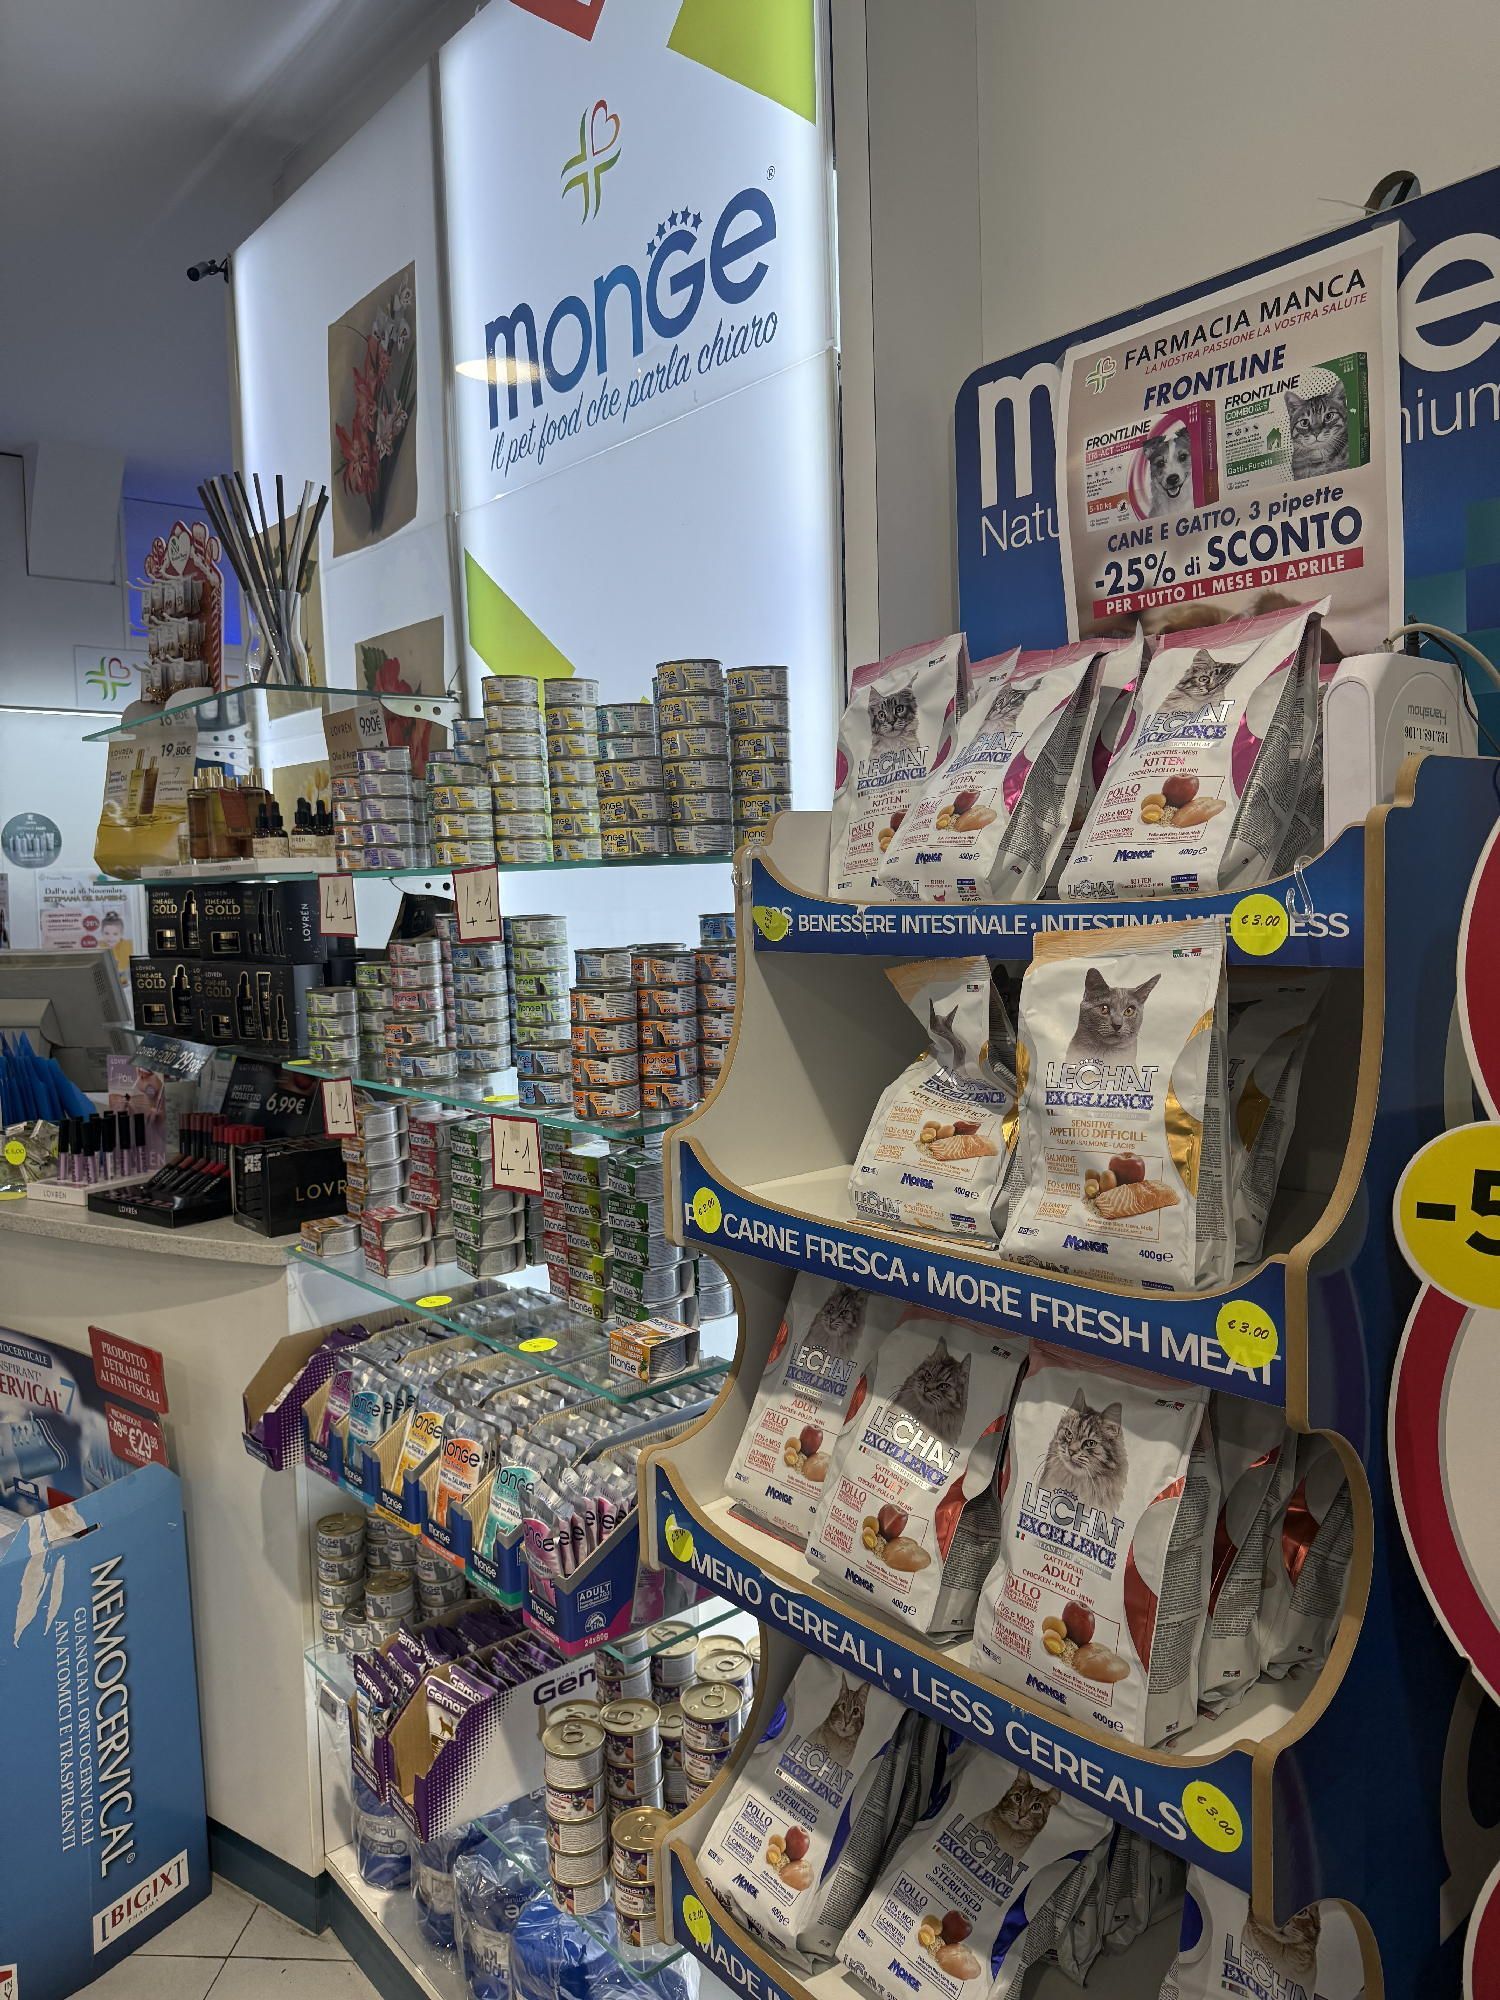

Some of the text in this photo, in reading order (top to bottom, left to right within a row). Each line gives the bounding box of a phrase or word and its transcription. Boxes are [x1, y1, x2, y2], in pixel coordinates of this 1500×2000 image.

[1124, 268, 1366, 370] FARMACIA MANCA
[1145, 291, 1368, 375] LA NOSTRA PASSIONE LA VOSTRA SALUTE
[1143, 343, 1287, 411] FRONTLINE
[1224, 374, 1300, 409] FRONTLINE
[490, 310, 779, 478] Il pet food che parla chiaro
[1226, 405, 1254, 420] COMBO
[1086, 419, 1151, 451] FRONTLINE
[1107, 485, 1344, 553] CANE E GATTO, 3 pipette
[1095, 505, 1363, 597] -25% di SCONTO
[1106, 553, 1345, 616] PER TUTTO IL MESE DI APRILE
[359, 715, 382, 737] 9,90€
[161, 743, 192, 758] 19,80€
[858, 745, 929, 780] LECHAT
[1143, 756, 1186, 767] KITTEN
[856, 766, 926, 791] EXCELLENCE
[1107, 783, 1141, 798] POLLO
[871, 795, 902, 808] KITTEN
[152, 904, 178, 915] GOLD
[204, 904, 241, 916] GOLD
[1252, 914, 1281, 928] 3.00
[798, 914, 897, 934] BENESSERE
[901, 914, 1028, 936] INTESTINALE
[137, 978, 167, 989] GOLD
[206, 986, 232, 998] GOLD
[1045, 1061, 1159, 1093] LECHAT
[266, 1091, 306, 1116] 6,99€
[1044, 1090, 1154, 1110] EXCELLENCE
[1049, 1127, 1148, 1142] APPETITO DIFFICILE
[1071, 1119, 1114, 1128] SENSITIVE
[1046, 1153, 1077, 1164] SALMONE
[900, 1172, 934, 1190] MONGE
[1062, 1234, 1109, 1255] MONGE
[723, 1213, 800, 1256] CARNE
[805, 1233, 908, 1287] FRESCA
[927, 1265, 1022, 1318] MORE
[1031, 1293, 1150, 1353] FRESH
[1239, 1320, 1270, 1340] 3.00
[101, 1341, 148, 1370] PRODOTTO
[790, 1343, 857, 1383] LECHAT
[103, 1356, 152, 1386] DETRAIBILE
[785, 1365, 848, 1397] EXCELLENCE
[60, 1376, 76, 1416] 7
[110, 1372, 160, 1405] FINI FISCALI
[765, 1411, 789, 1427] POLLO
[791, 1399, 820, 1415] ADULT
[868, 1405, 960, 1473] LECHAT
[862, 1428, 949, 1487] EXCELLENCE
[765, 1485, 794, 1506] MONGE
[840, 1479, 867, 1502] POLLO
[871, 1472, 904, 1496] ADULT
[1022, 1481, 1125, 1550] LECHAT
[1017, 1511, 1117, 1570] EXCELLENCE
[844, 1567, 875, 1594] MONGE
[1022, 1568, 1051, 1586] CHICKEN
[1041, 1563, 1082, 1588] ADULT
[579, 1583, 610, 1601] ADULT
[691, 1551, 1187, 1842] MENO CEREALI LESS CEREALS
[1026, 1672, 1067, 1705] MONGE
[73, 1606, 94, 1847] GUANCIALI ORTOCERVICALI
[90, 1556, 135, 1878] MEMOCERVICAL
[55, 1620, 76, 1853] ANATOMICI E TRASPIRANTI
[788, 1735, 854, 1794] LECHAT
[778, 1756, 844, 1808] EXCELLENCE
[746, 1801, 773, 1827] POLLO
[776, 1789, 818, 1825] STERILISED
[1206, 1805, 1236, 1837] 3.00
[945, 1812, 1030, 1886] LECHAT
[935, 1831, 1014, 1900] EXCELLENCE
[732, 1873, 760, 1900] MONGE
[898, 1876, 929, 1907] POLLO
[931, 1866, 983, 1913] STERILISED
[902, 1912, 916, 1927] MOS
[696, 1933, 761, 1999] MADE
[888, 1958, 923, 1993] MONGE
